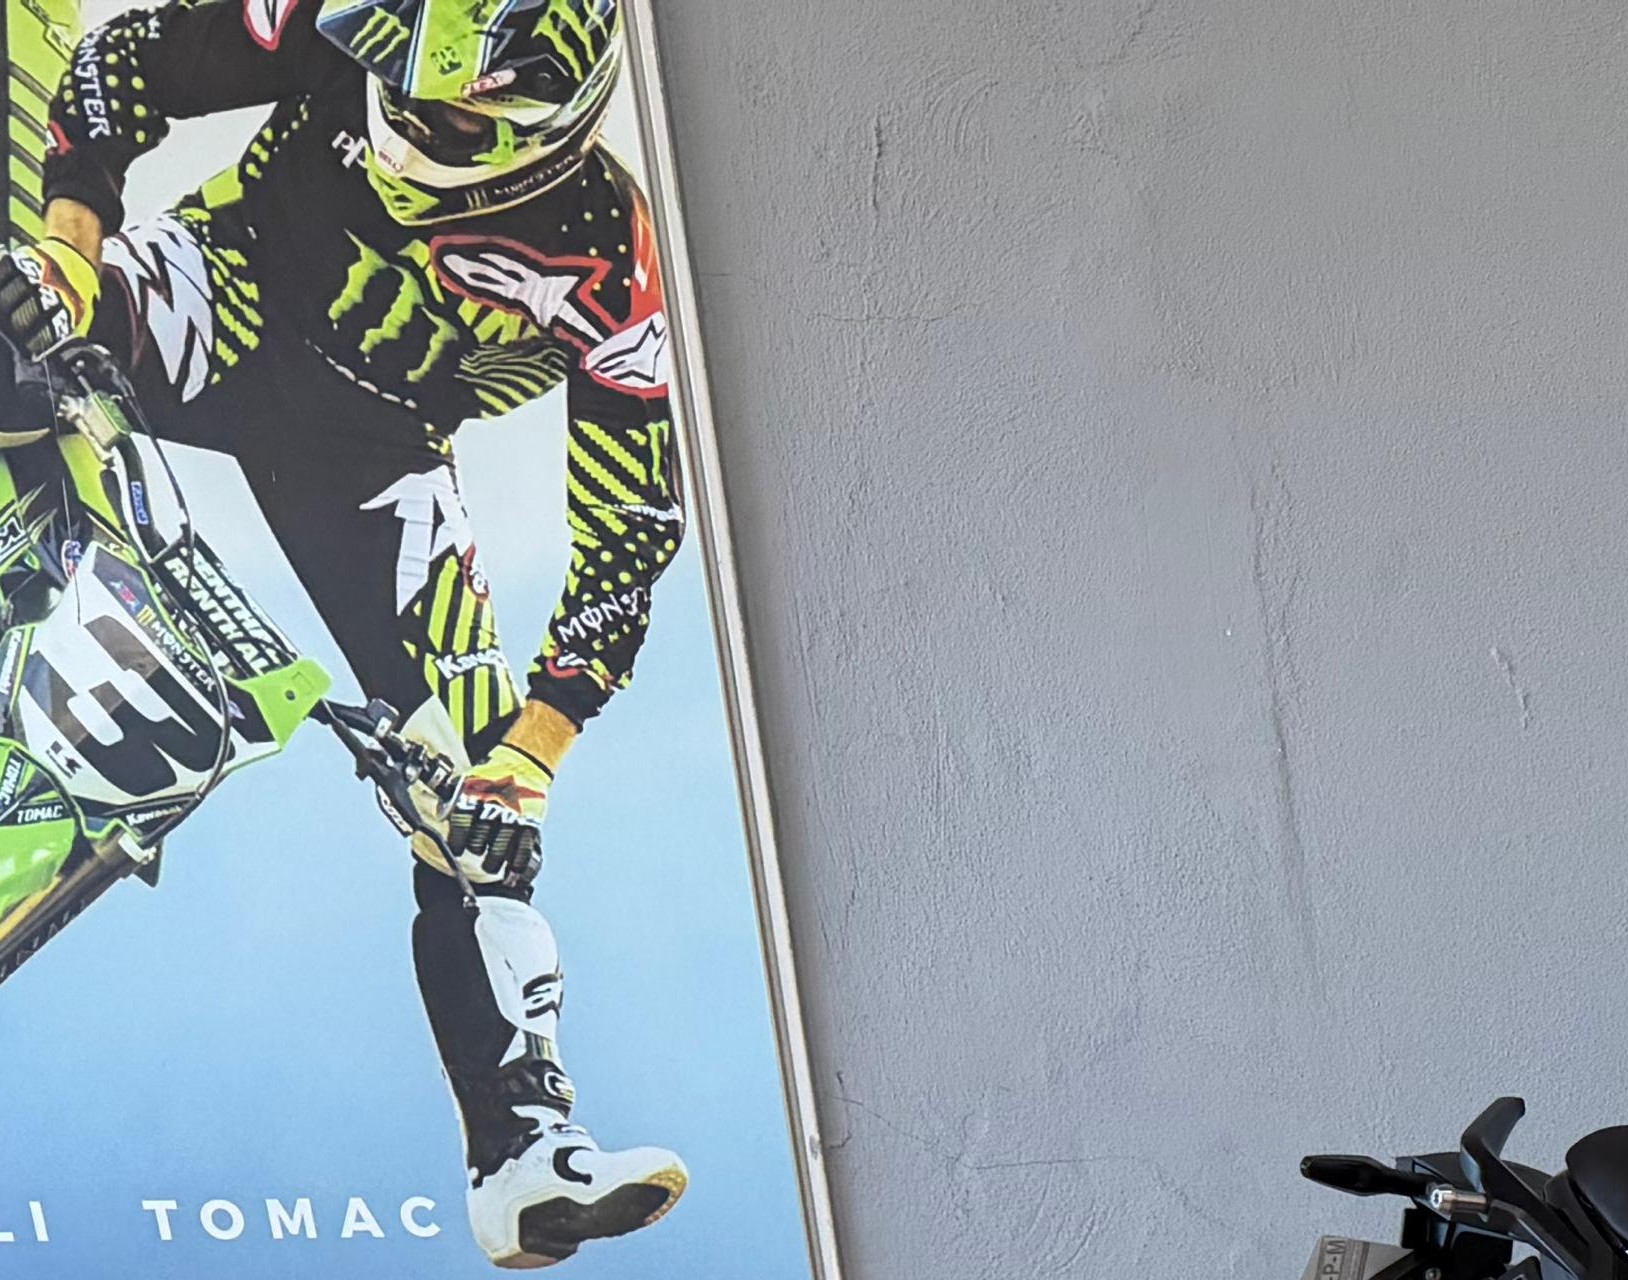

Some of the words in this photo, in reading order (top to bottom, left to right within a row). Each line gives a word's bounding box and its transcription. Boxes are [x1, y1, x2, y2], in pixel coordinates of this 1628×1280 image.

[16, 804, 64, 824] TOMAC
[0, 1200, 50, 1243] I
[143, 1196, 442, 1242] TOMAC
